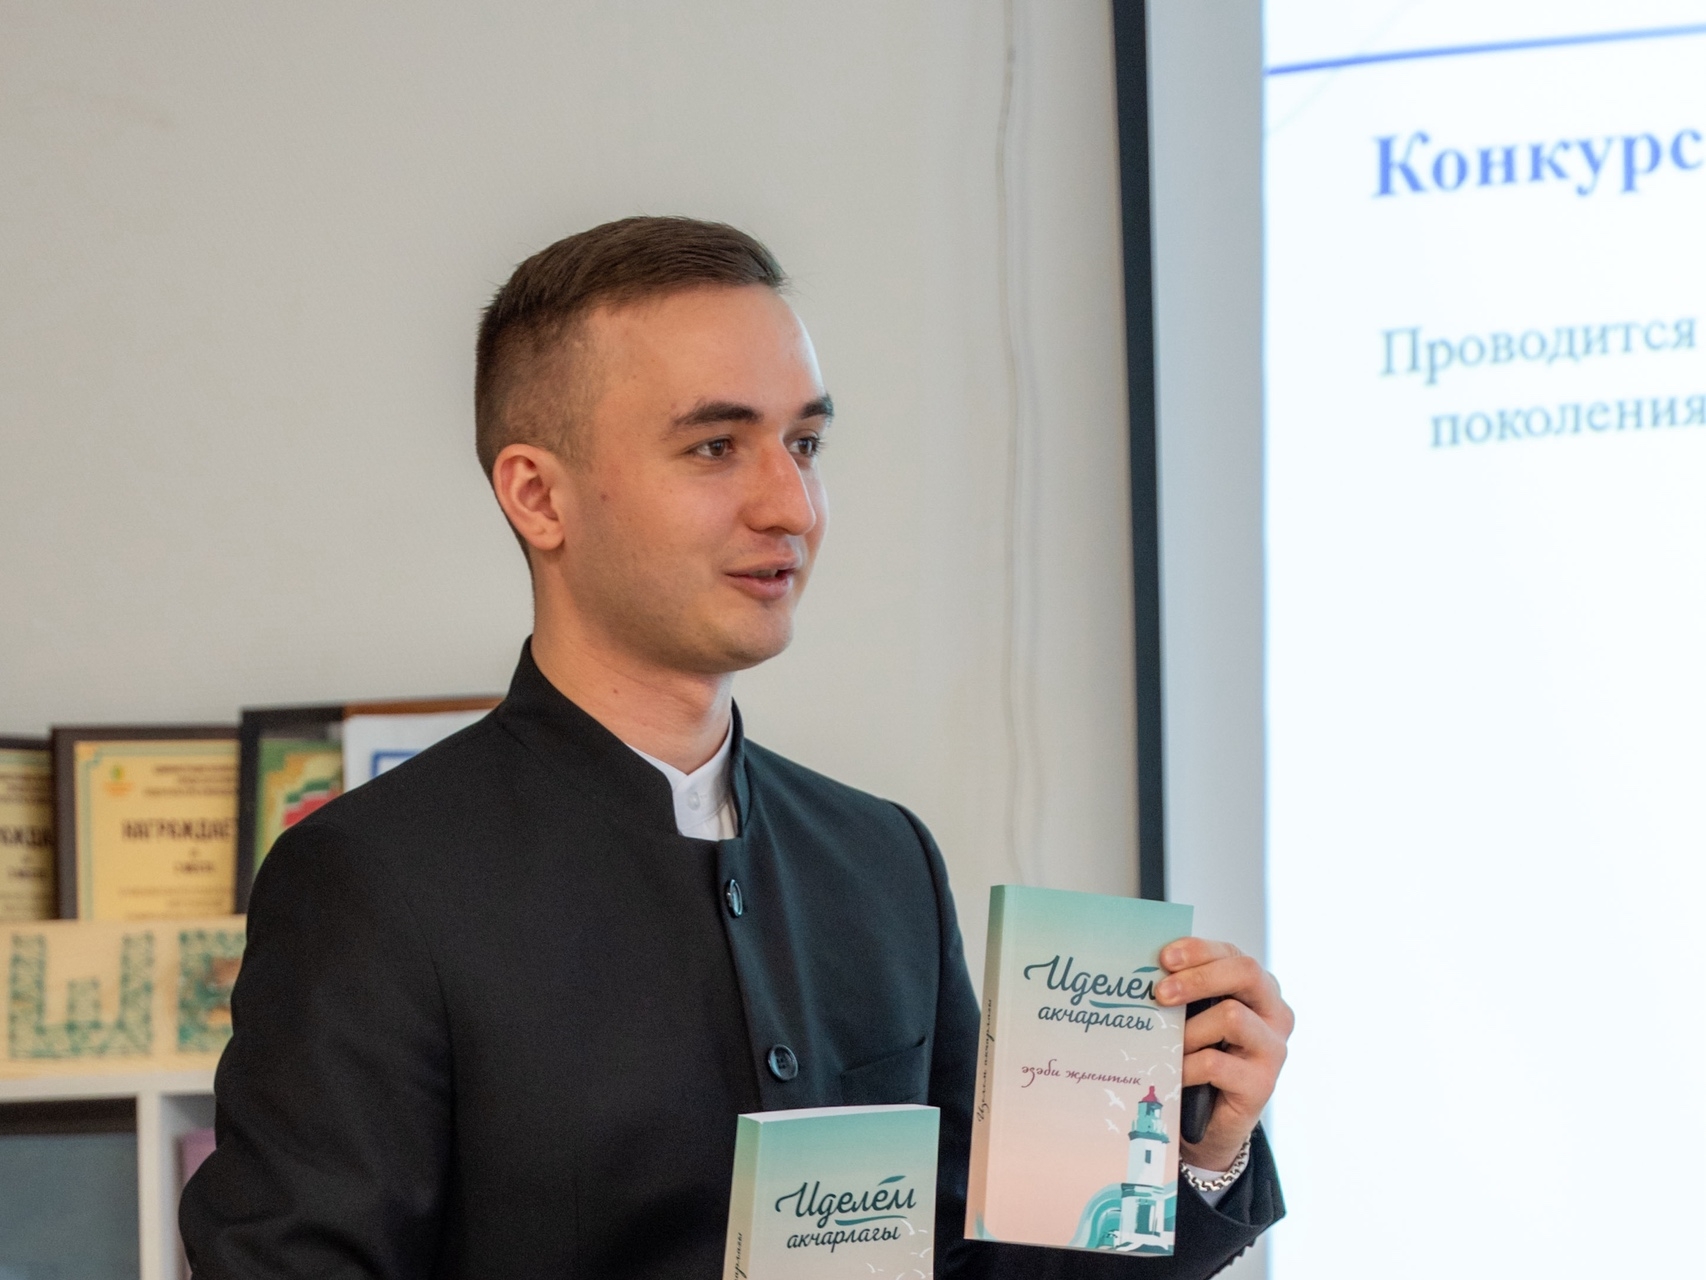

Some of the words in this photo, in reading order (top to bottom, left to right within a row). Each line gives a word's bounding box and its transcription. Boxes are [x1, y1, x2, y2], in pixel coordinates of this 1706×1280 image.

[1373, 129, 1705, 197] Конкурс
[1380, 317, 1697, 386] Проводится
[1430, 393, 1706, 448] поколения
[1037, 1003, 1154, 1033] акчарлагы
[774, 1180, 917, 1228] Иделем
[786, 1224, 902, 1253] акчарлагы
